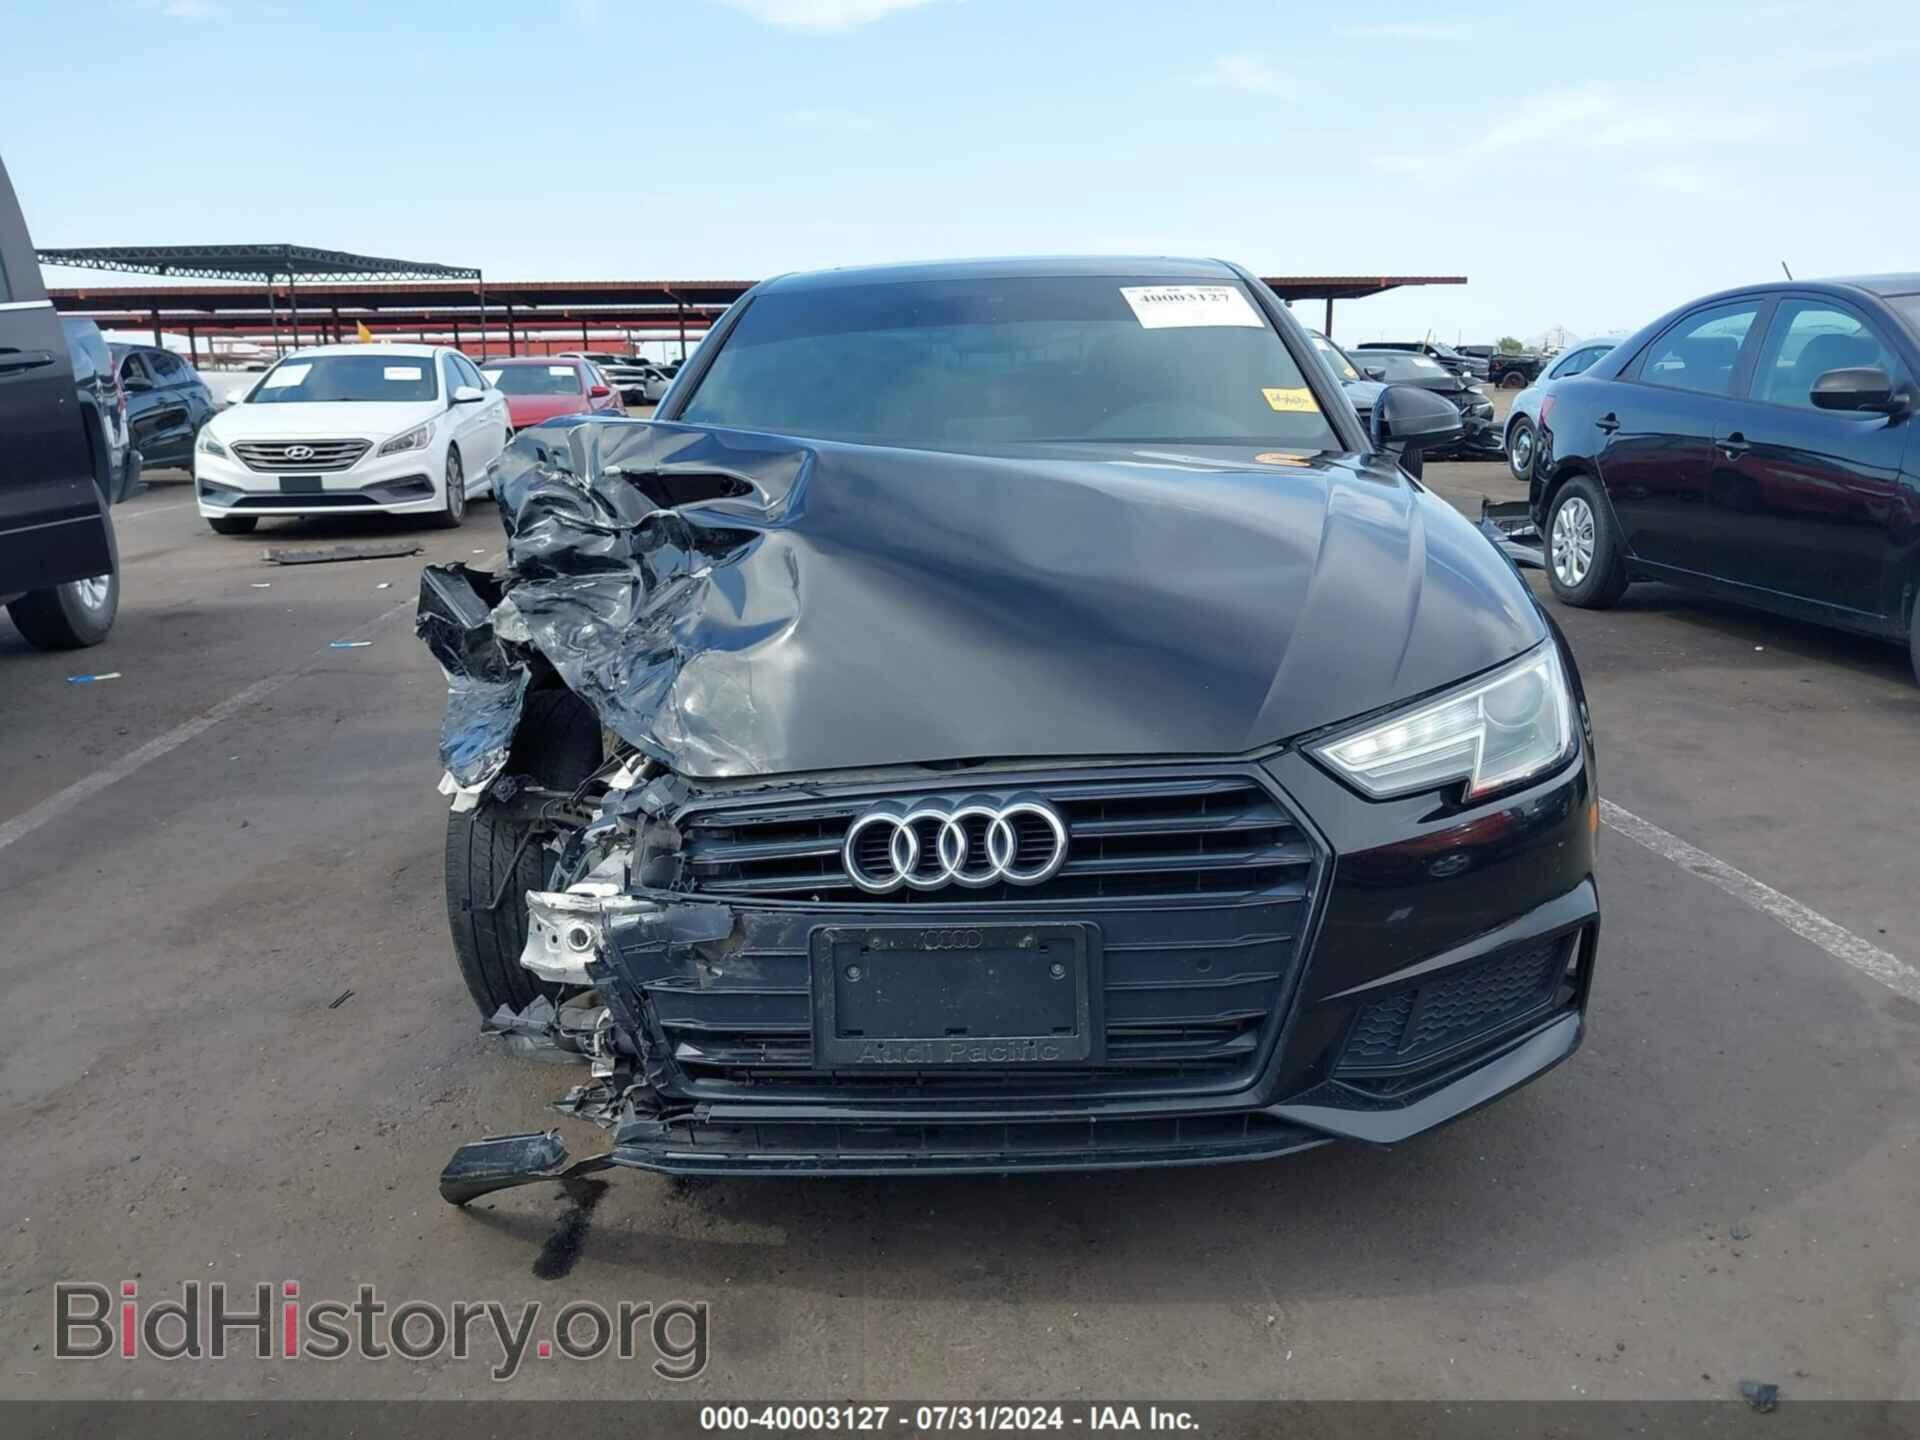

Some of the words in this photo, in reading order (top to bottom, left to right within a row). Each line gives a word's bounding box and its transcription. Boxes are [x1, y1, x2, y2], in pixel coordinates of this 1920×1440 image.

[1140, 293, 1229, 303] 40003127
[856, 1041, 933, 1064] Audi
[944, 1040, 1060, 1063] Pacific
